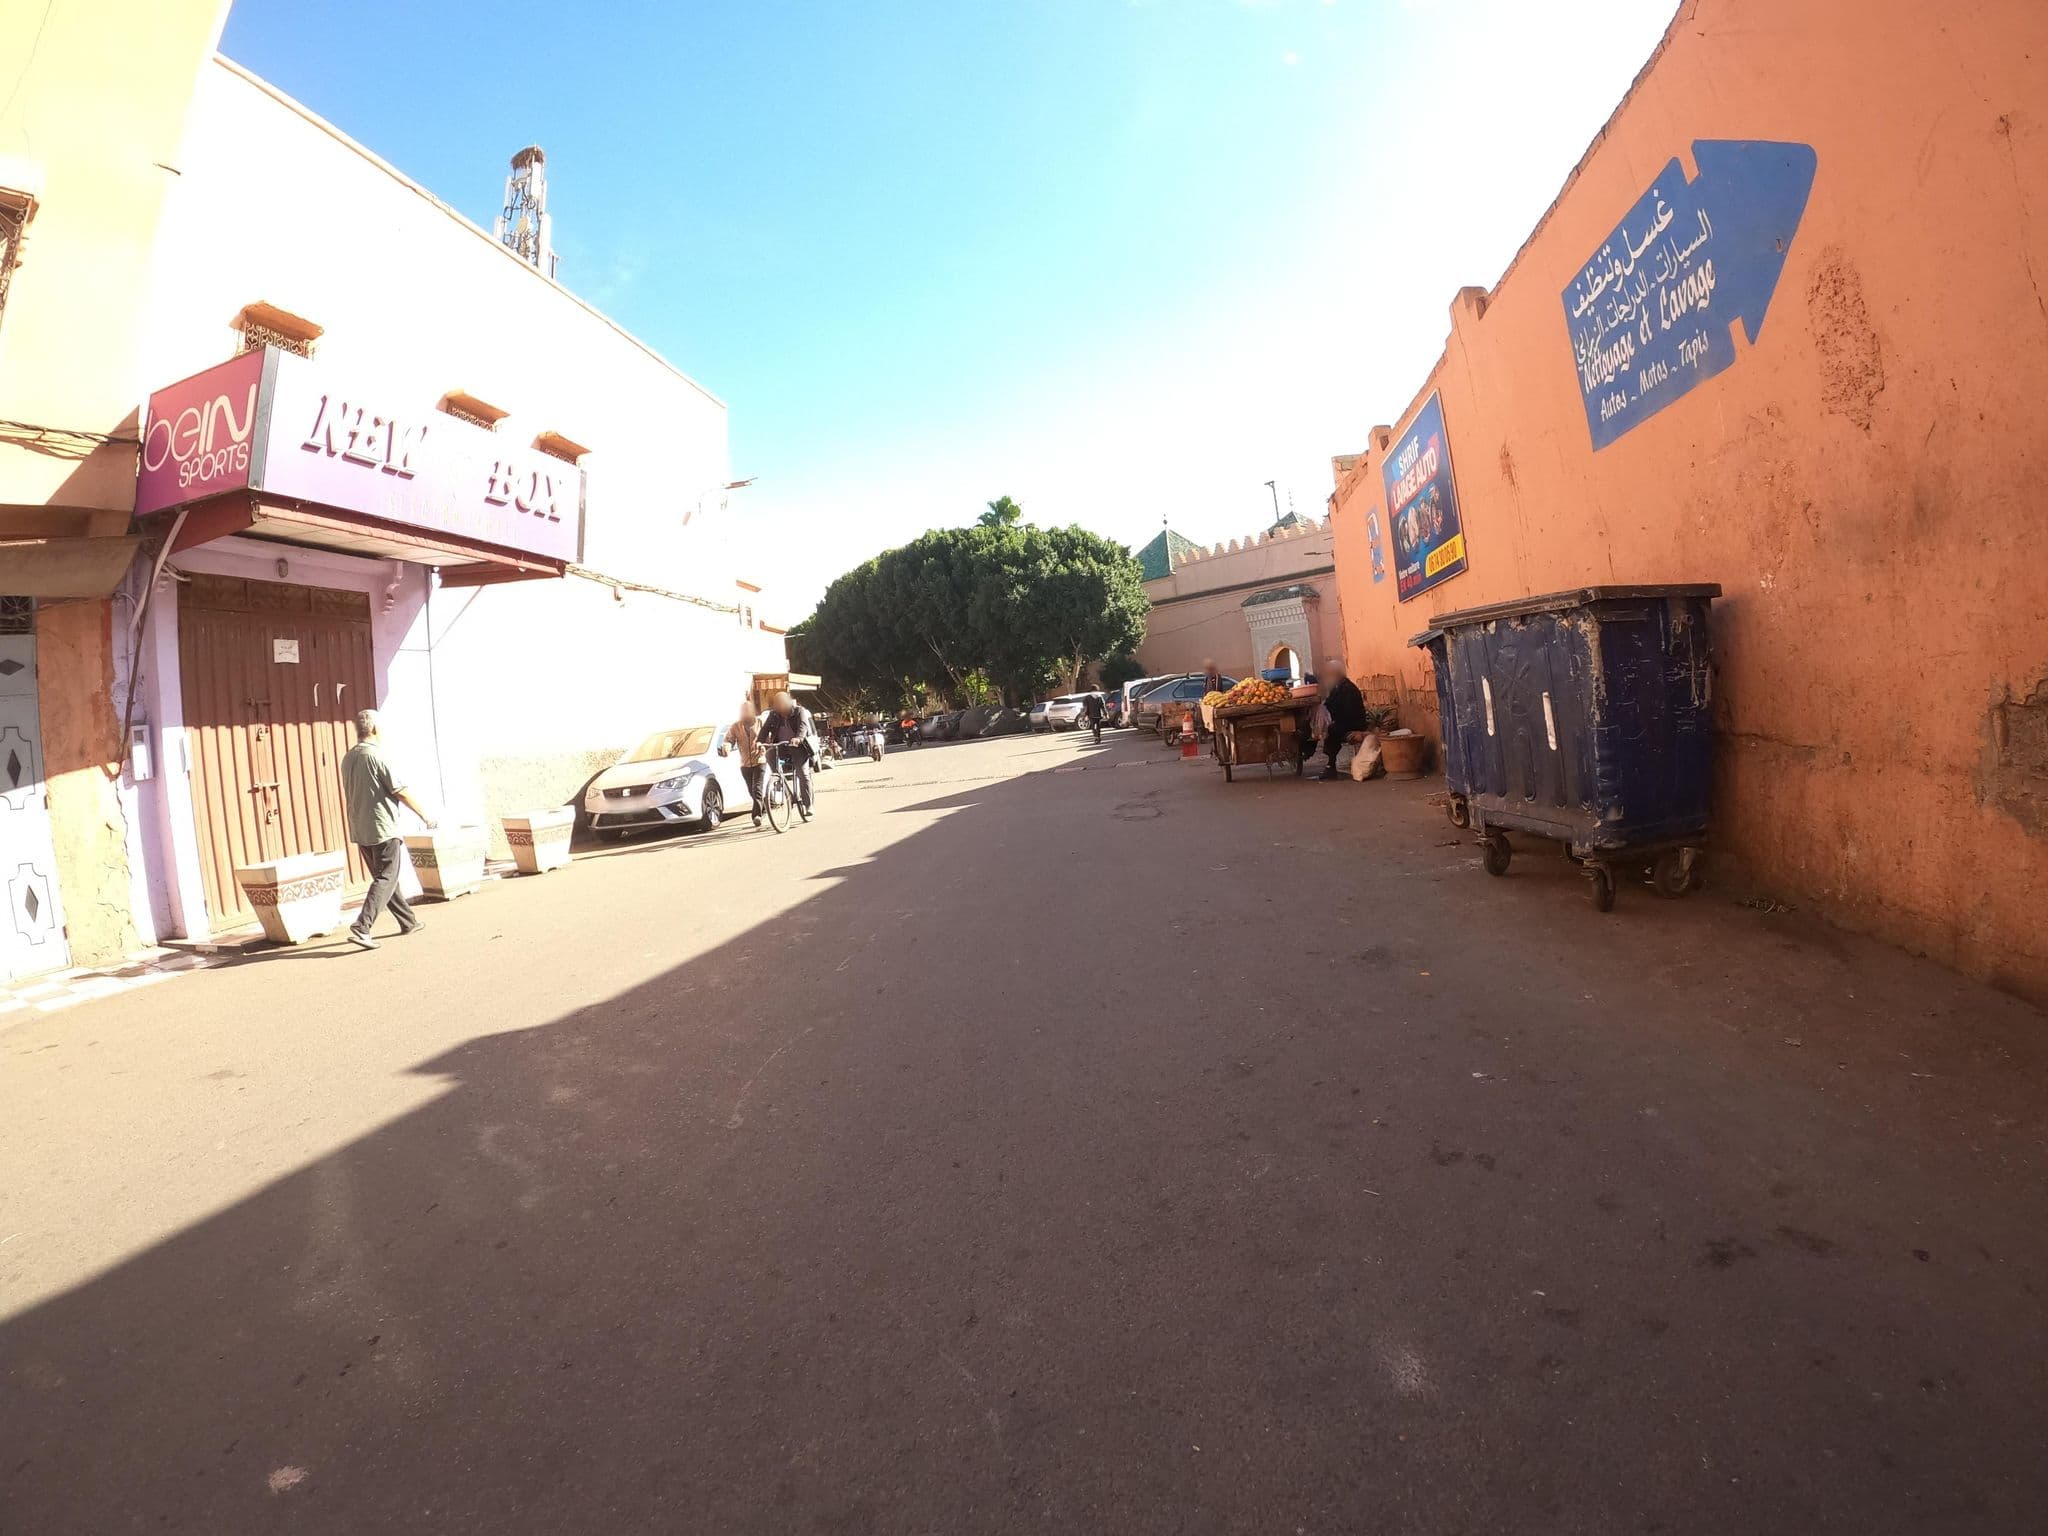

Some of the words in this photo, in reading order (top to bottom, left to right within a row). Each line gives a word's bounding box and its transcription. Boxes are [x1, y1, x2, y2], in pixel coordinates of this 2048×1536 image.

[1655, 208, 1713, 282] السيارات
[1639, 304, 1653, 346] et
[1659, 258, 1716, 331] Lavage
[1600, 388, 1627, 422] Autos
[1639, 360, 1668, 396] Motos
[1678, 328, 1709, 369] Tapis
[178, 442, 249, 488] SPORTS
[301, 393, 429, 480] NEW
[1398, 435, 1419, 476] SHRIF
[1393, 468, 1418, 511] LAVAGE
[1416, 446, 1437, 489] AUTO
